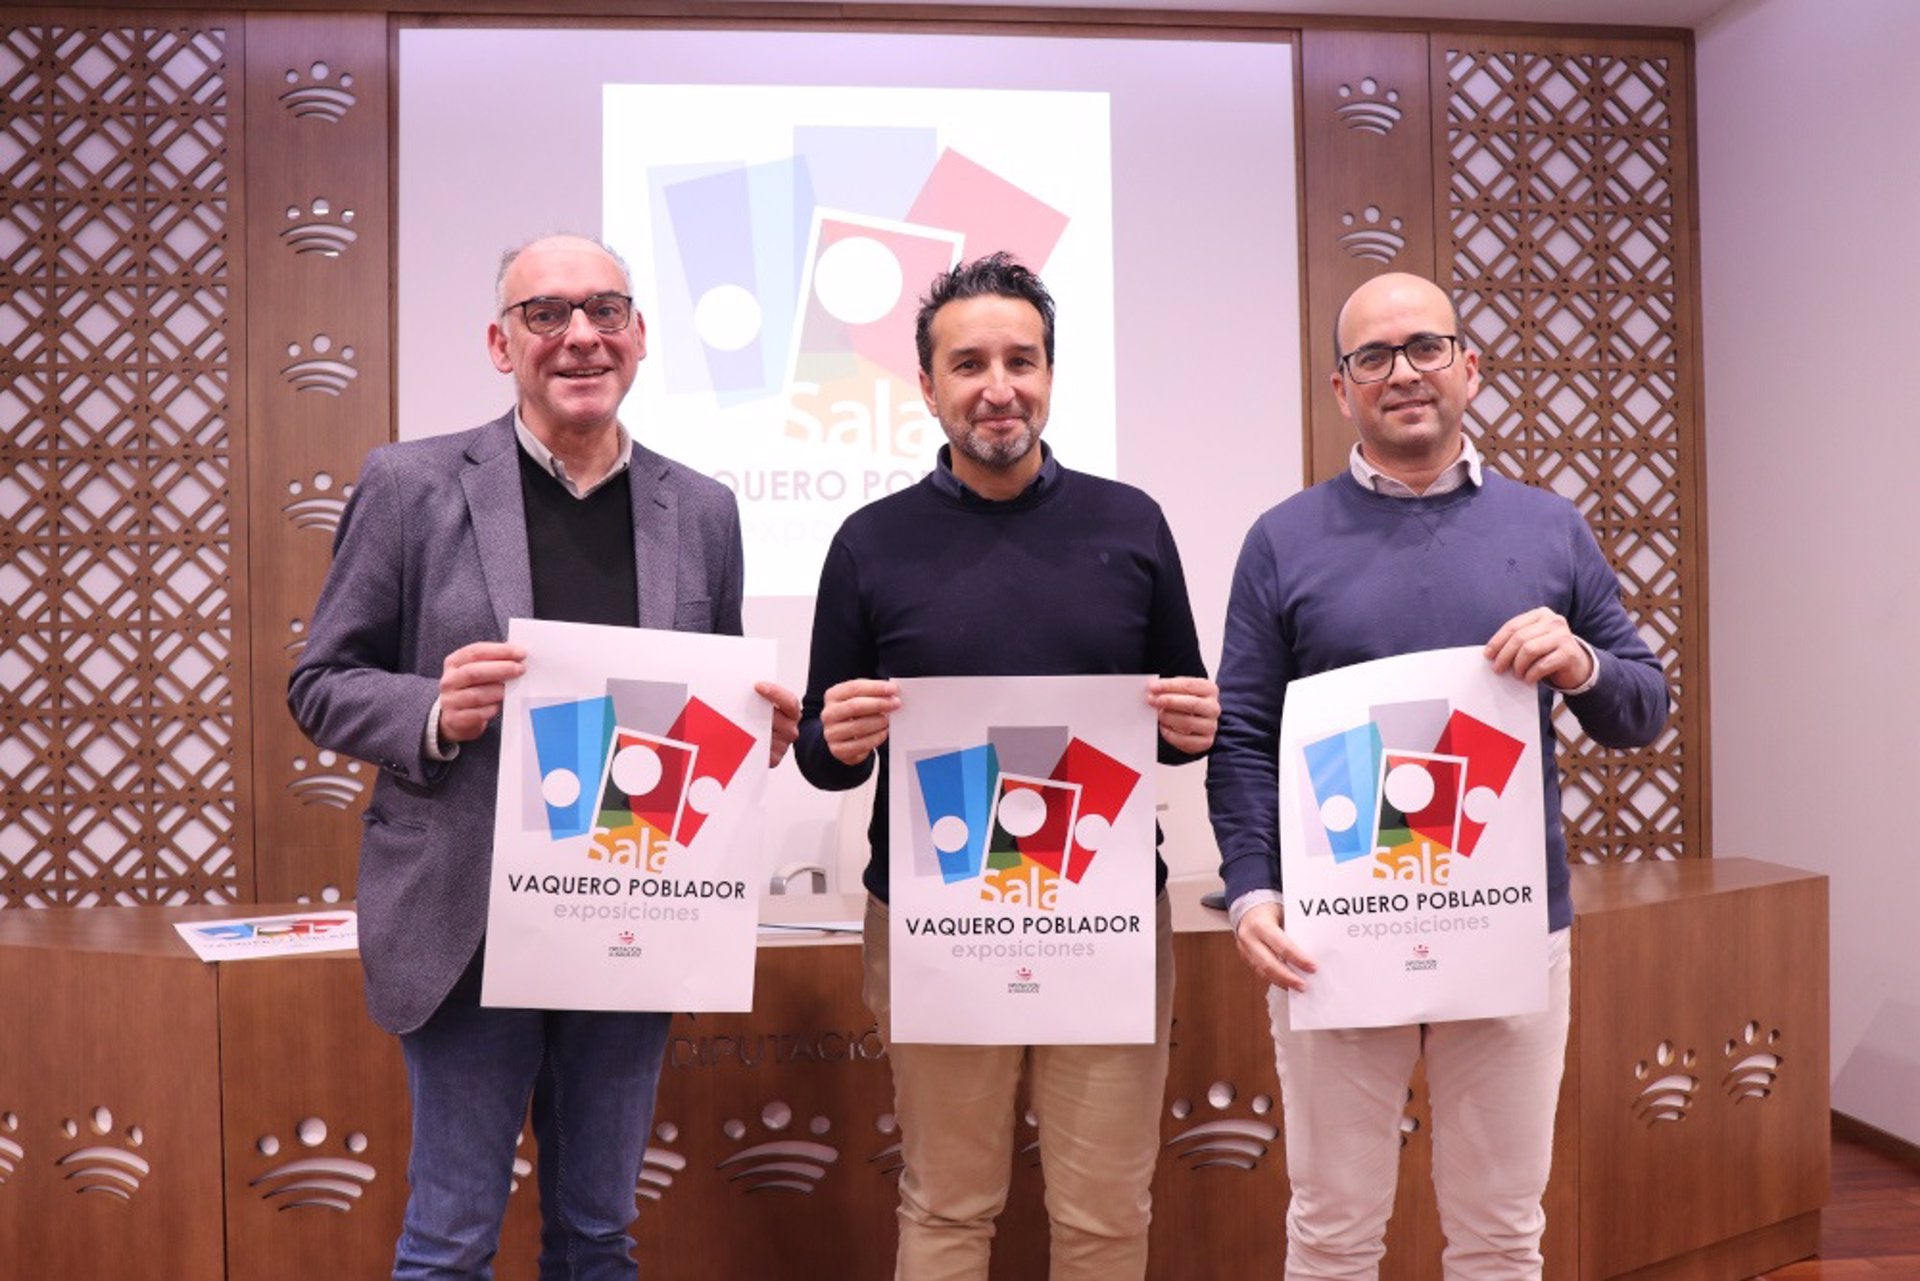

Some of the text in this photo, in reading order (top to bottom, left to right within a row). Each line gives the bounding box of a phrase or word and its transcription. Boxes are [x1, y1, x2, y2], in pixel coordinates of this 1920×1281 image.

[784, 379, 934, 459] Sala
[587, 827, 672, 873] Sala
[1373, 842, 1455, 886] Sala
[508, 874, 746, 900] VAQUERO POBLADOR
[980, 866, 1063, 911] Sala
[1300, 885, 1533, 917] VAQUERO POBLADOR
[554, 902, 700, 922] exposiciones
[906, 915, 1141, 936] VAQUERO POBLADOR
[1347, 914, 1490, 940] exposiciones
[951, 939, 1096, 961] exposiciones
